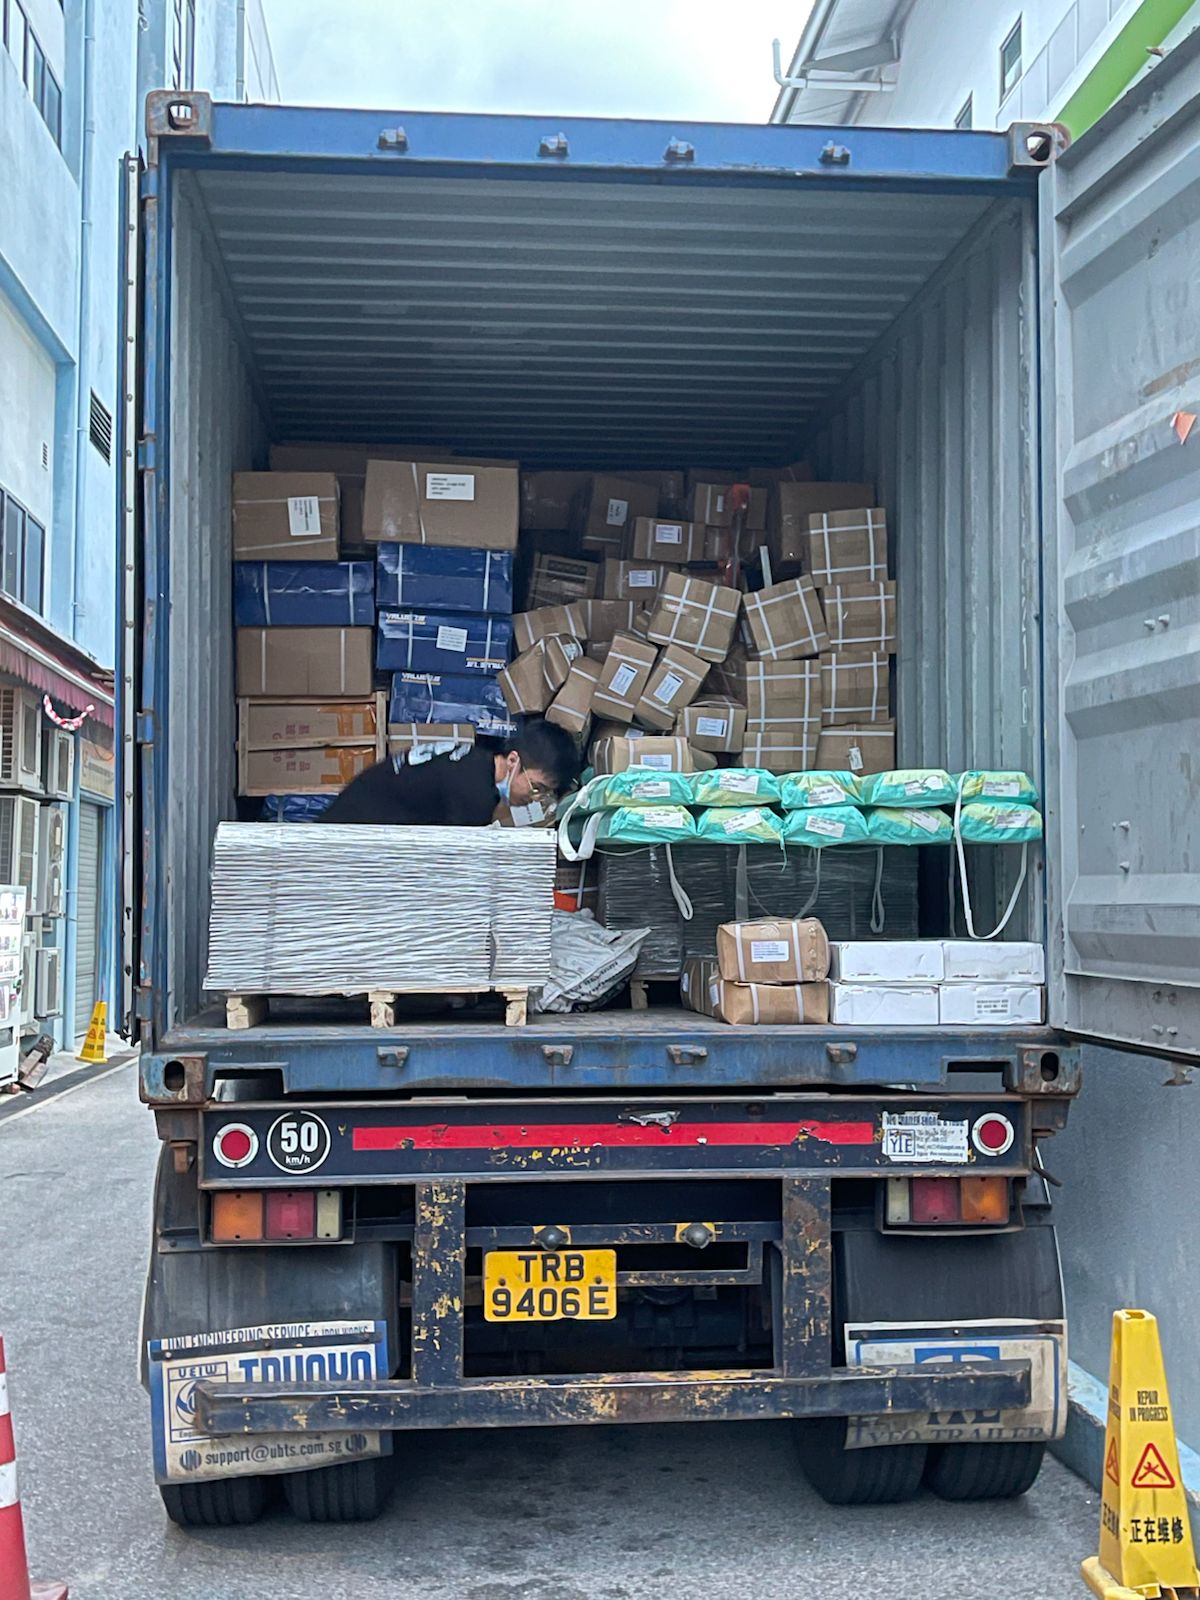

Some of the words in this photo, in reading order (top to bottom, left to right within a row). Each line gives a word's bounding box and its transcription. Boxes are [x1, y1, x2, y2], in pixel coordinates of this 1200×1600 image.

[281, 1121, 319, 1153] 50
[286, 1154, 310, 1165] km/h
[518, 1253, 585, 1283] TRB
[492, 1286, 610, 1317] 9406E
[1137, 1390, 1158, 1406] REPAIR
[1130, 1408, 1137, 1421] IN
[1138, 1407, 1168, 1421] PROGRESS
[204, 1440, 343, 1466] support@ubts.com.sg
[1129, 1516, 1184, 1545] 正在维修
